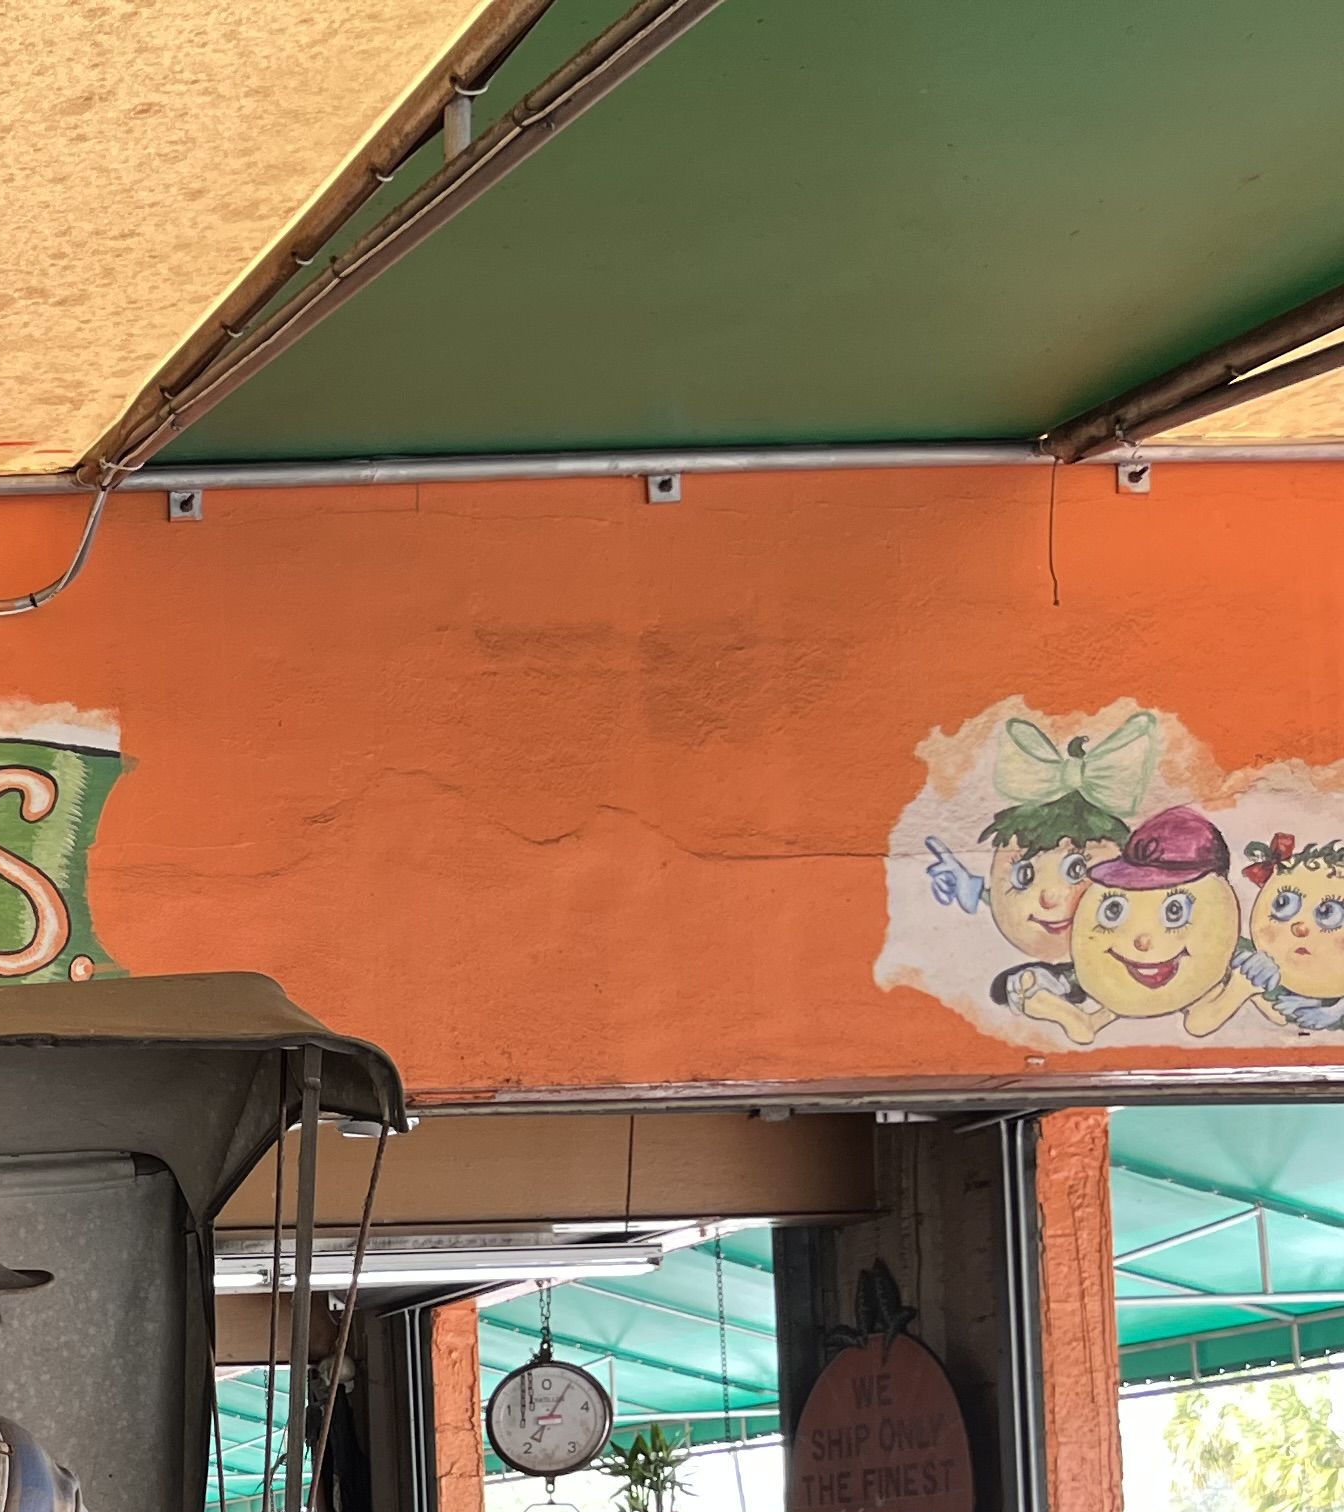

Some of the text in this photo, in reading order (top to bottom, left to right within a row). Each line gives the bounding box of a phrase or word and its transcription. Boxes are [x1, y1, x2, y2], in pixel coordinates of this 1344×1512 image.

[580, 1401, 590, 1413] 4
[852, 1374, 892, 1410] WE
[523, 1442, 576, 1454] 2 3
[812, 1414, 944, 1461] SHIP ONLY
[802, 1458, 954, 1506] THE FINEST
